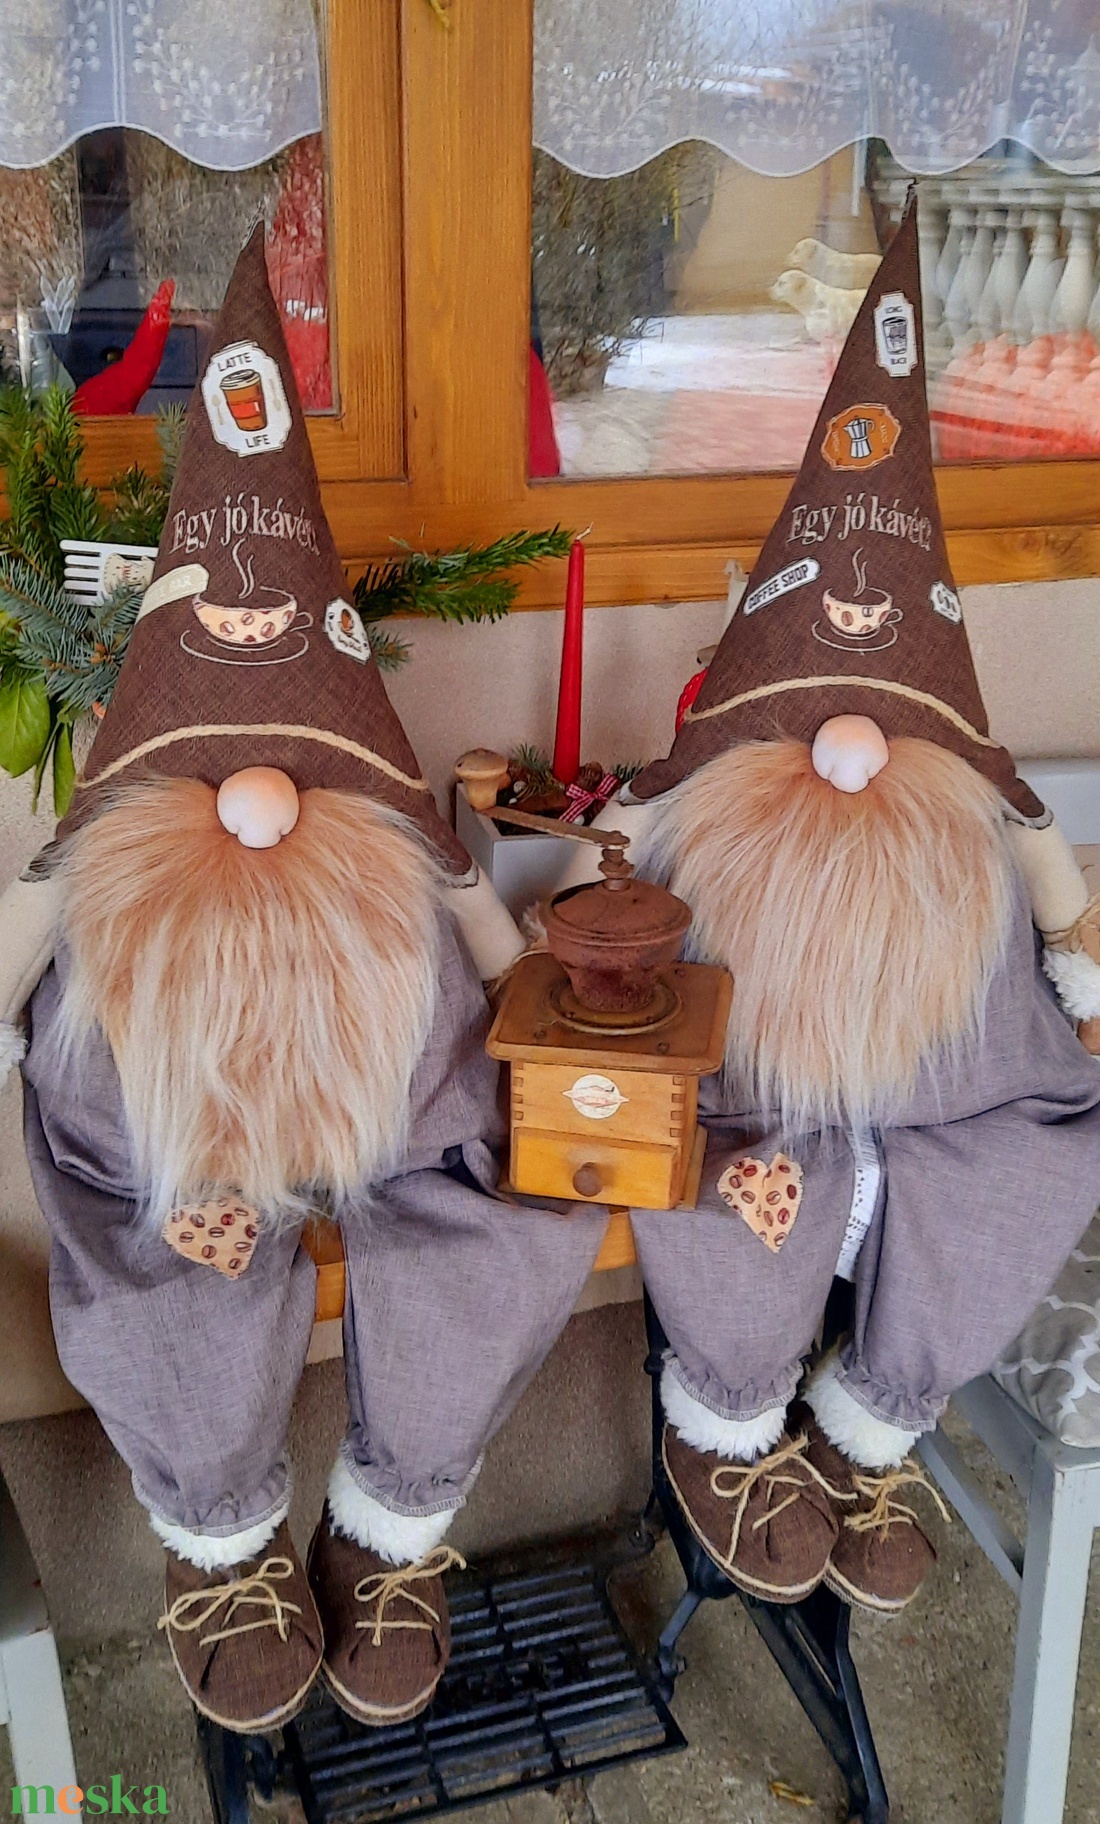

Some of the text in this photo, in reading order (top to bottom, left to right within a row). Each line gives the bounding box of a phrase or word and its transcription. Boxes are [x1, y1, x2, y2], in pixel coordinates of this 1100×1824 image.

[217, 352, 252, 372] LATTE
[245, 434, 270, 449] LIFE
[169, 507, 217, 554] Egy
[221, 492, 247, 546] jó
[786, 504, 838, 545] Egy
[838, 492, 866, 541] jó
[781, 564, 809, 588] SHOP
